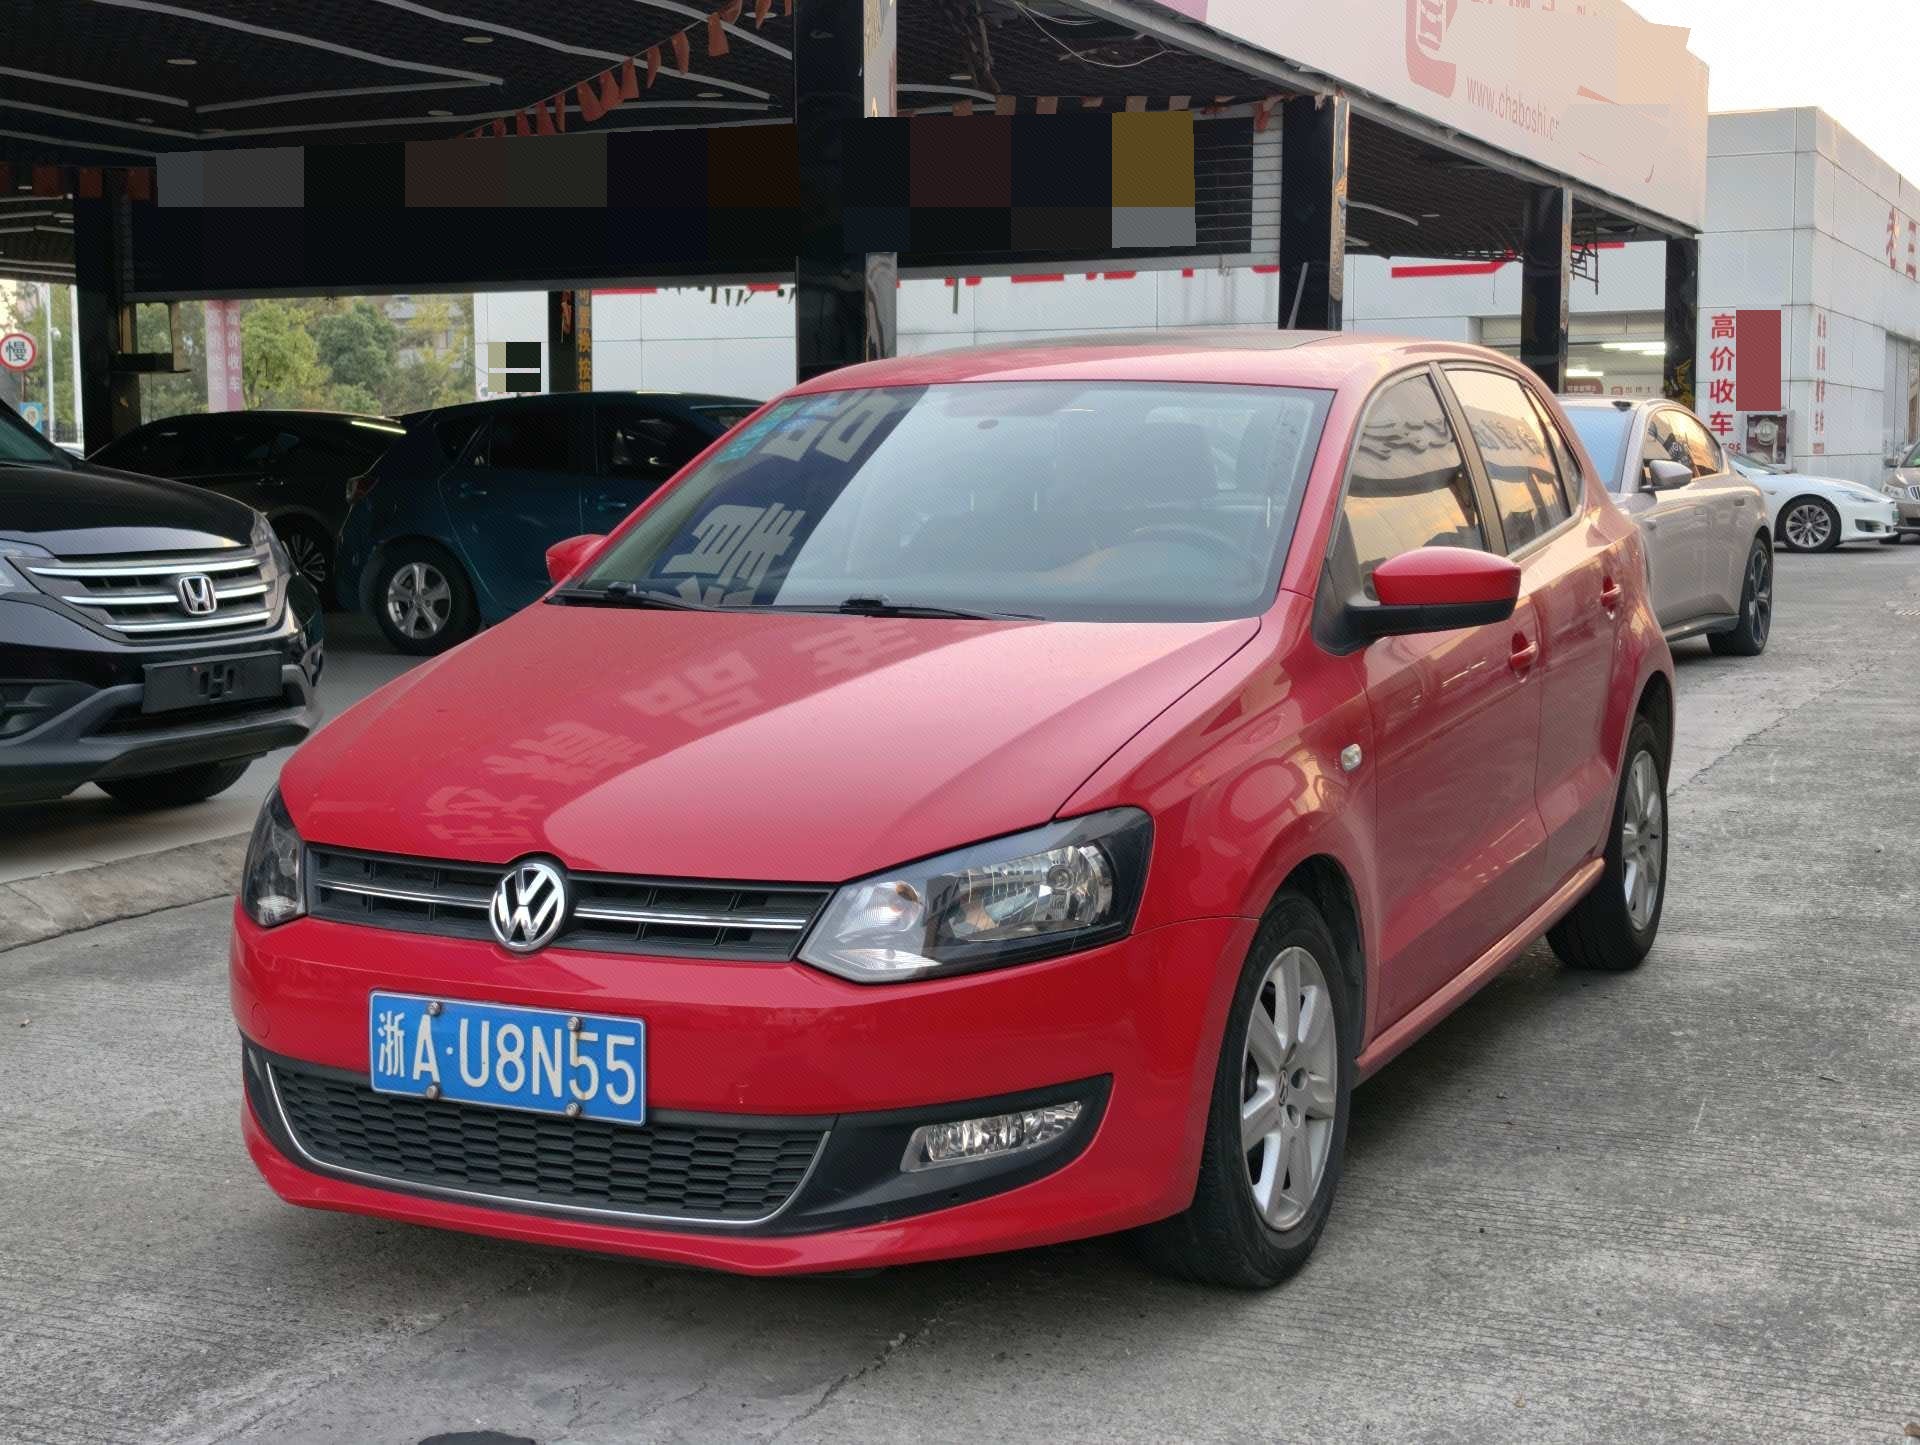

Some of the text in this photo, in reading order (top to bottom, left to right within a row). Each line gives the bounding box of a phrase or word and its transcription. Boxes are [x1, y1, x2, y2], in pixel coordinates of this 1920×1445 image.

[5, 341, 27, 361] 慢
[1709, 313, 1736, 436] 高价收车
[378, 1010, 636, 1105] 浙A·U8N55
